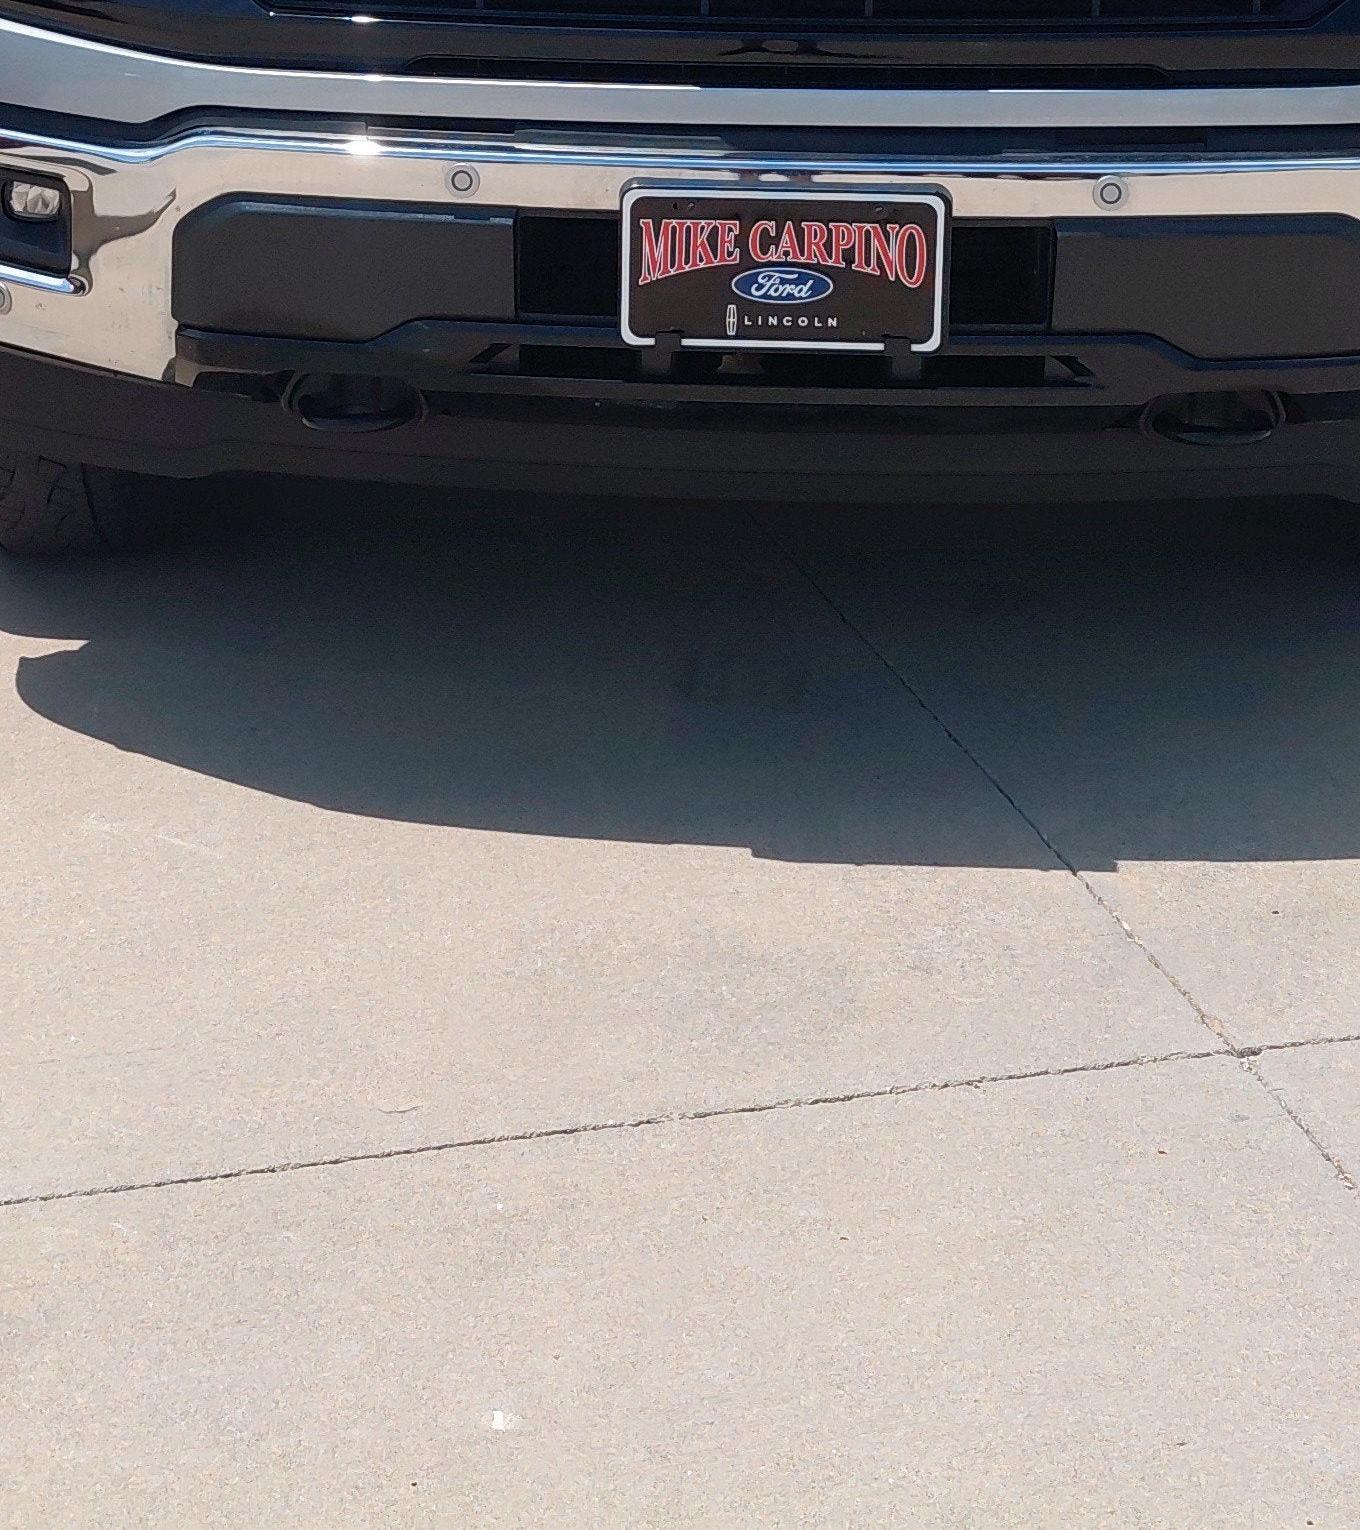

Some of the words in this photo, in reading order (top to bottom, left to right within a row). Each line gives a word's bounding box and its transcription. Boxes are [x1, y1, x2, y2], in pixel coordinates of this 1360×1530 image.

[638, 218, 740, 286] MIKE
[748, 220, 928, 289] CARPINO
[750, 270, 816, 299] Ford
[743, 314, 839, 328] LINCOLN
